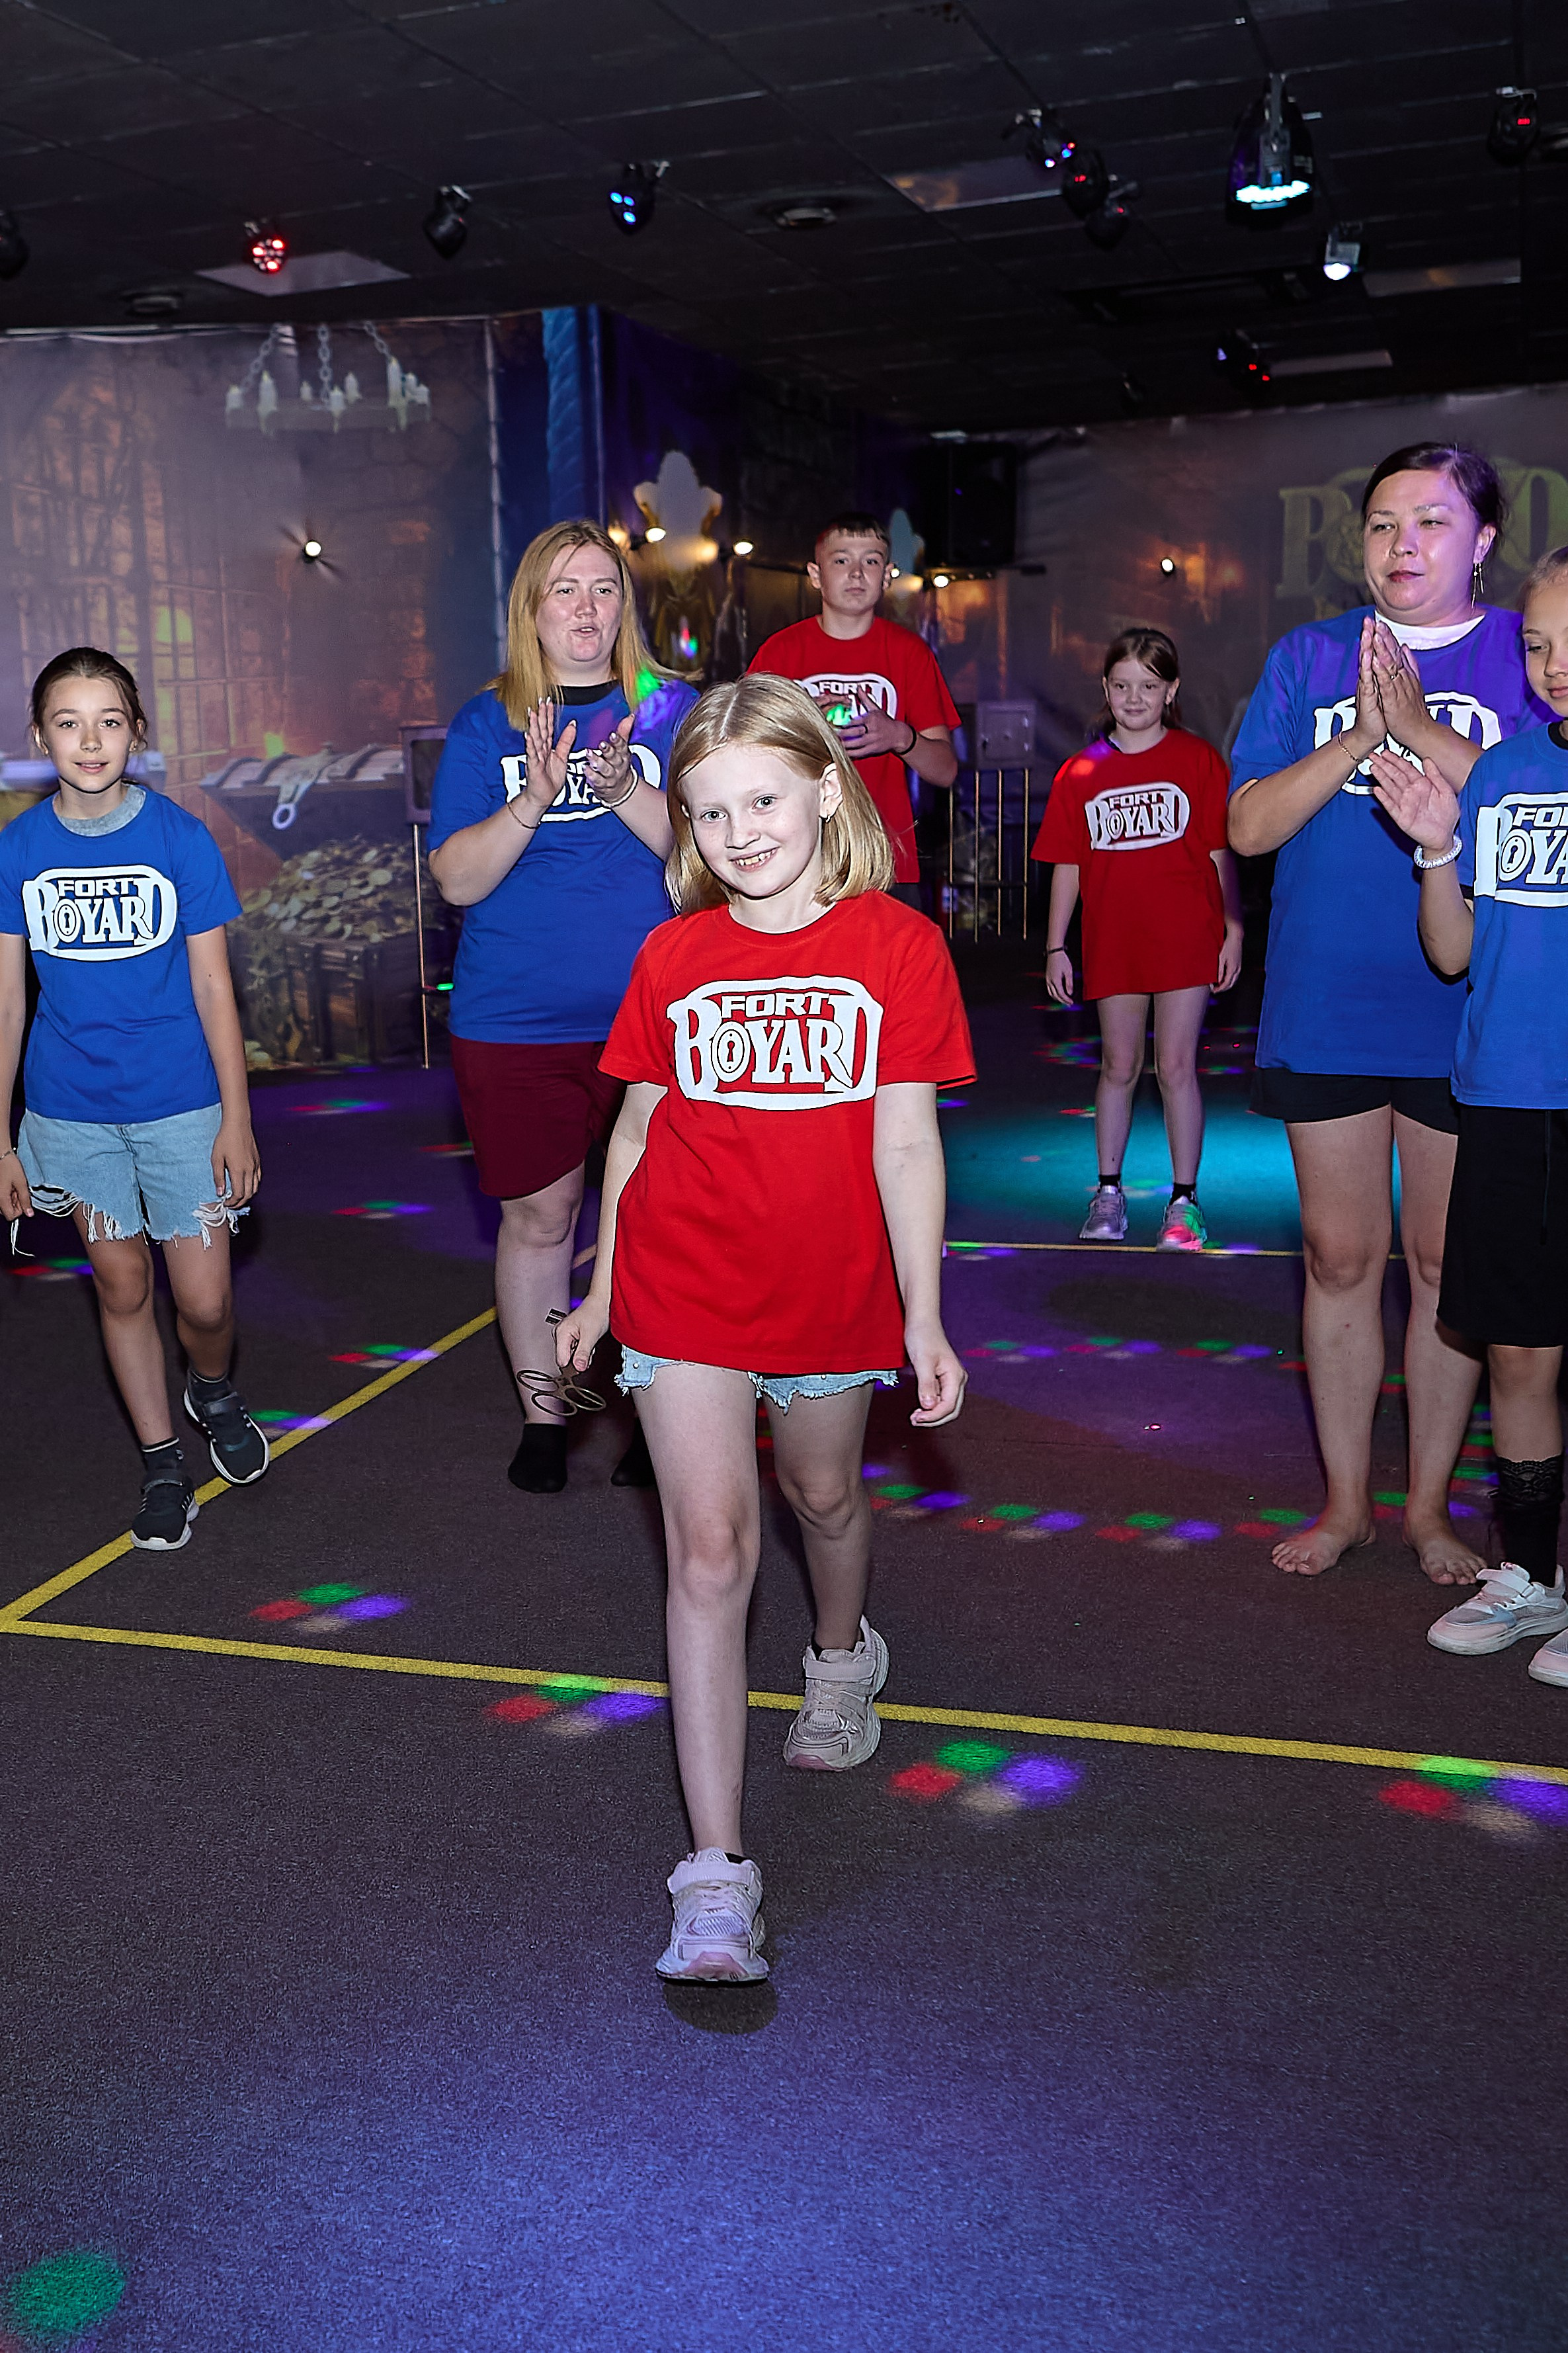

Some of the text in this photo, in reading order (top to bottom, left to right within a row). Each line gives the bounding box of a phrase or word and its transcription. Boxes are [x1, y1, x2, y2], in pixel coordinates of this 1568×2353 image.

[1109, 791, 1163, 809] FORT
[1085, 789, 1190, 850] BOYARD
[1512, 806, 1568, 827] FO
[58, 877, 134, 897] FORT
[22, 872, 177, 951] BOYARD
[722, 992, 829, 1018] FORT
[667, 992, 884, 1099] BOYARD
